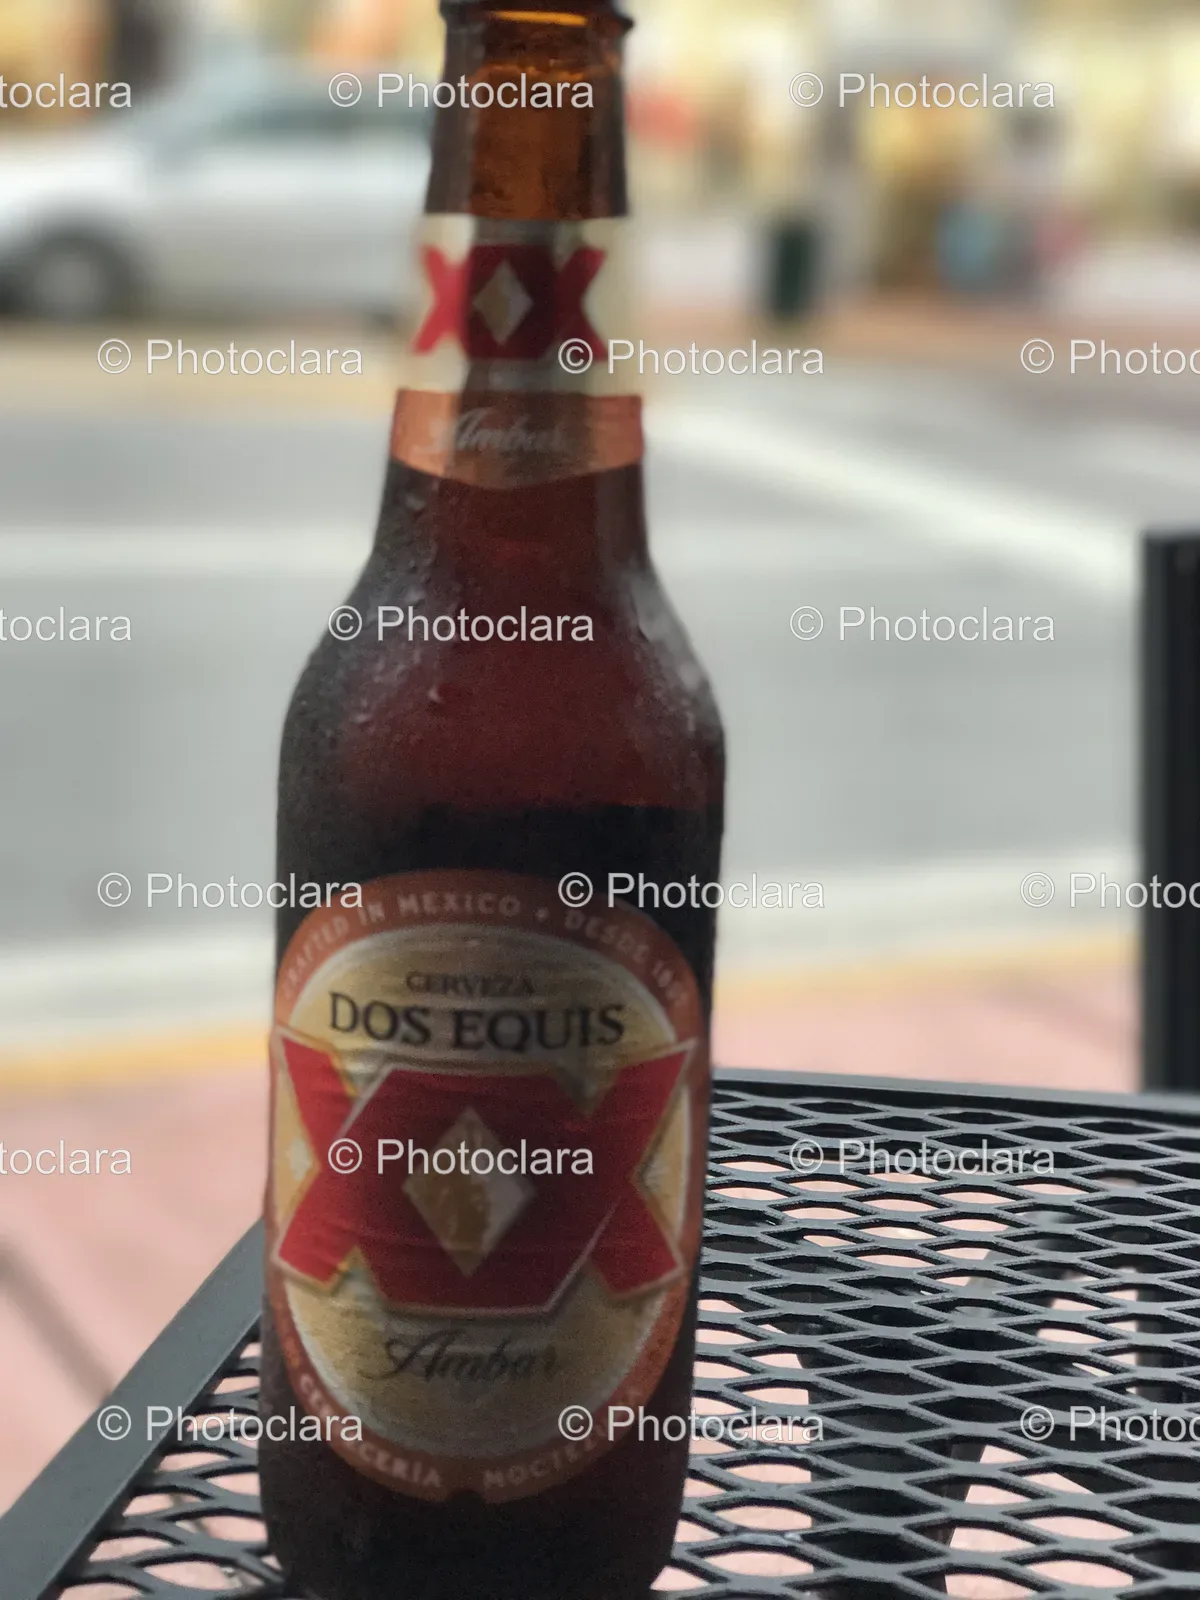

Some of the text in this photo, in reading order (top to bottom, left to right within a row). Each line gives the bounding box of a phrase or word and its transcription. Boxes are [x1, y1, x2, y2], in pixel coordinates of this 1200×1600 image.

[396, 890, 521, 917] MEXICO
[564, 909, 650, 964] DESDE
[405, 970, 535, 998] CERVEZA
[329, 991, 627, 1055] DOS EQUIS
[358, 1327, 558, 1382] Ambar
